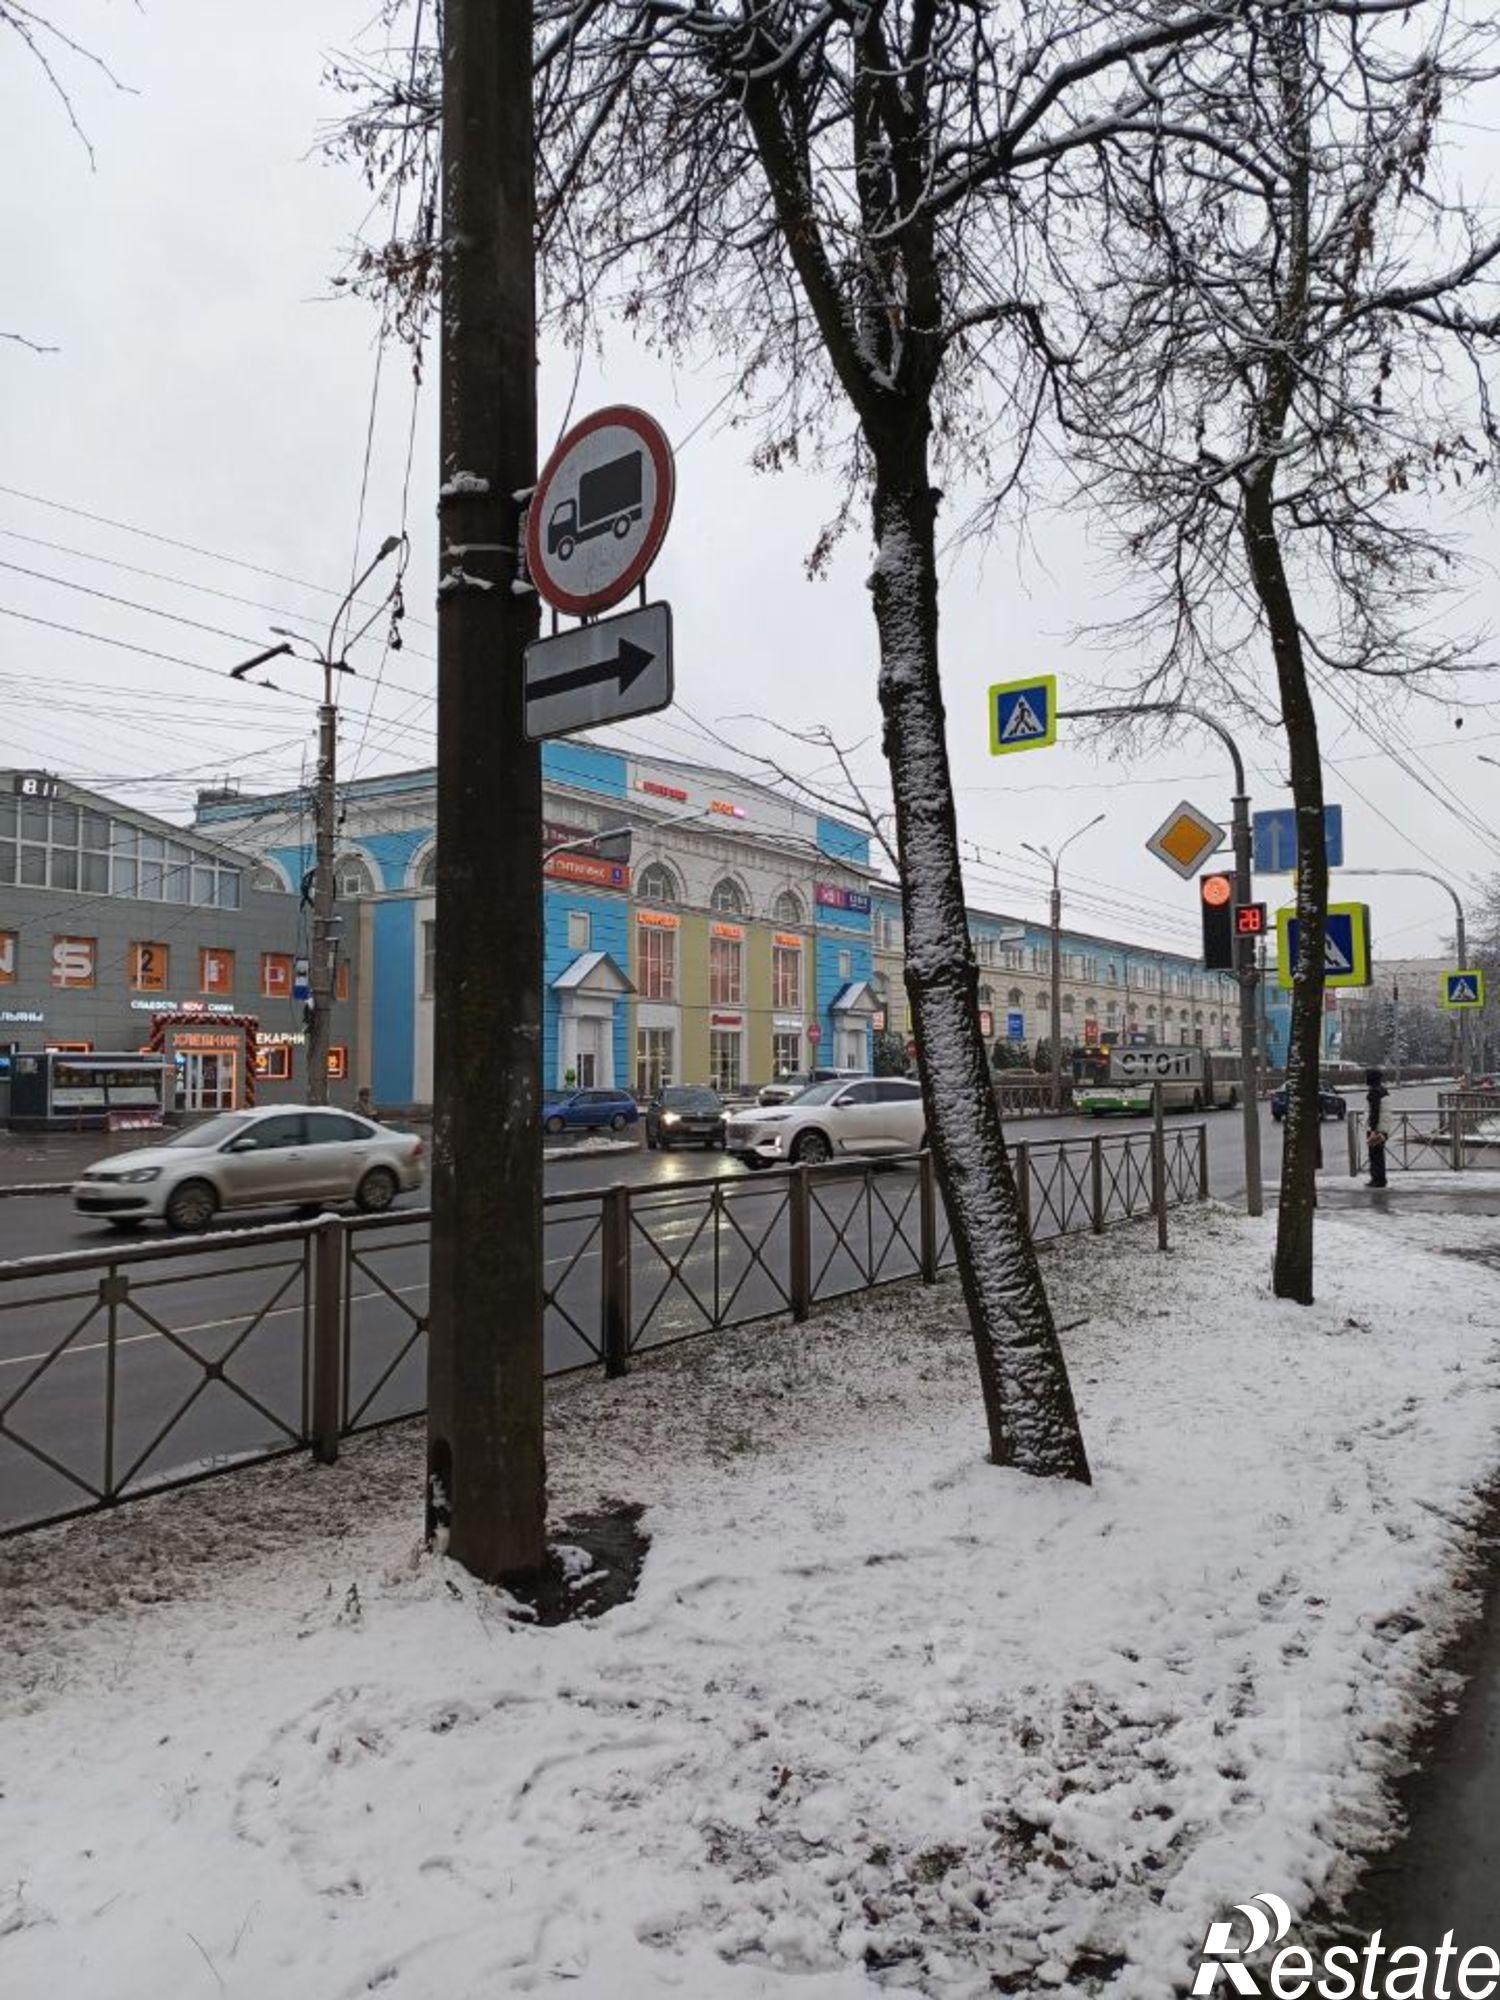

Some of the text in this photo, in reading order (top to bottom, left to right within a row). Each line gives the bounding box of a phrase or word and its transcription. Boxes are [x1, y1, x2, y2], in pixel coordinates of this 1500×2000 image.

[1239, 909, 1260, 932] 28
[141, 950, 153, 972] 2
[0, 1011, 44, 1022] ЛЬЯНЫ
[1122, 1053, 1190, 1075] СТОП
